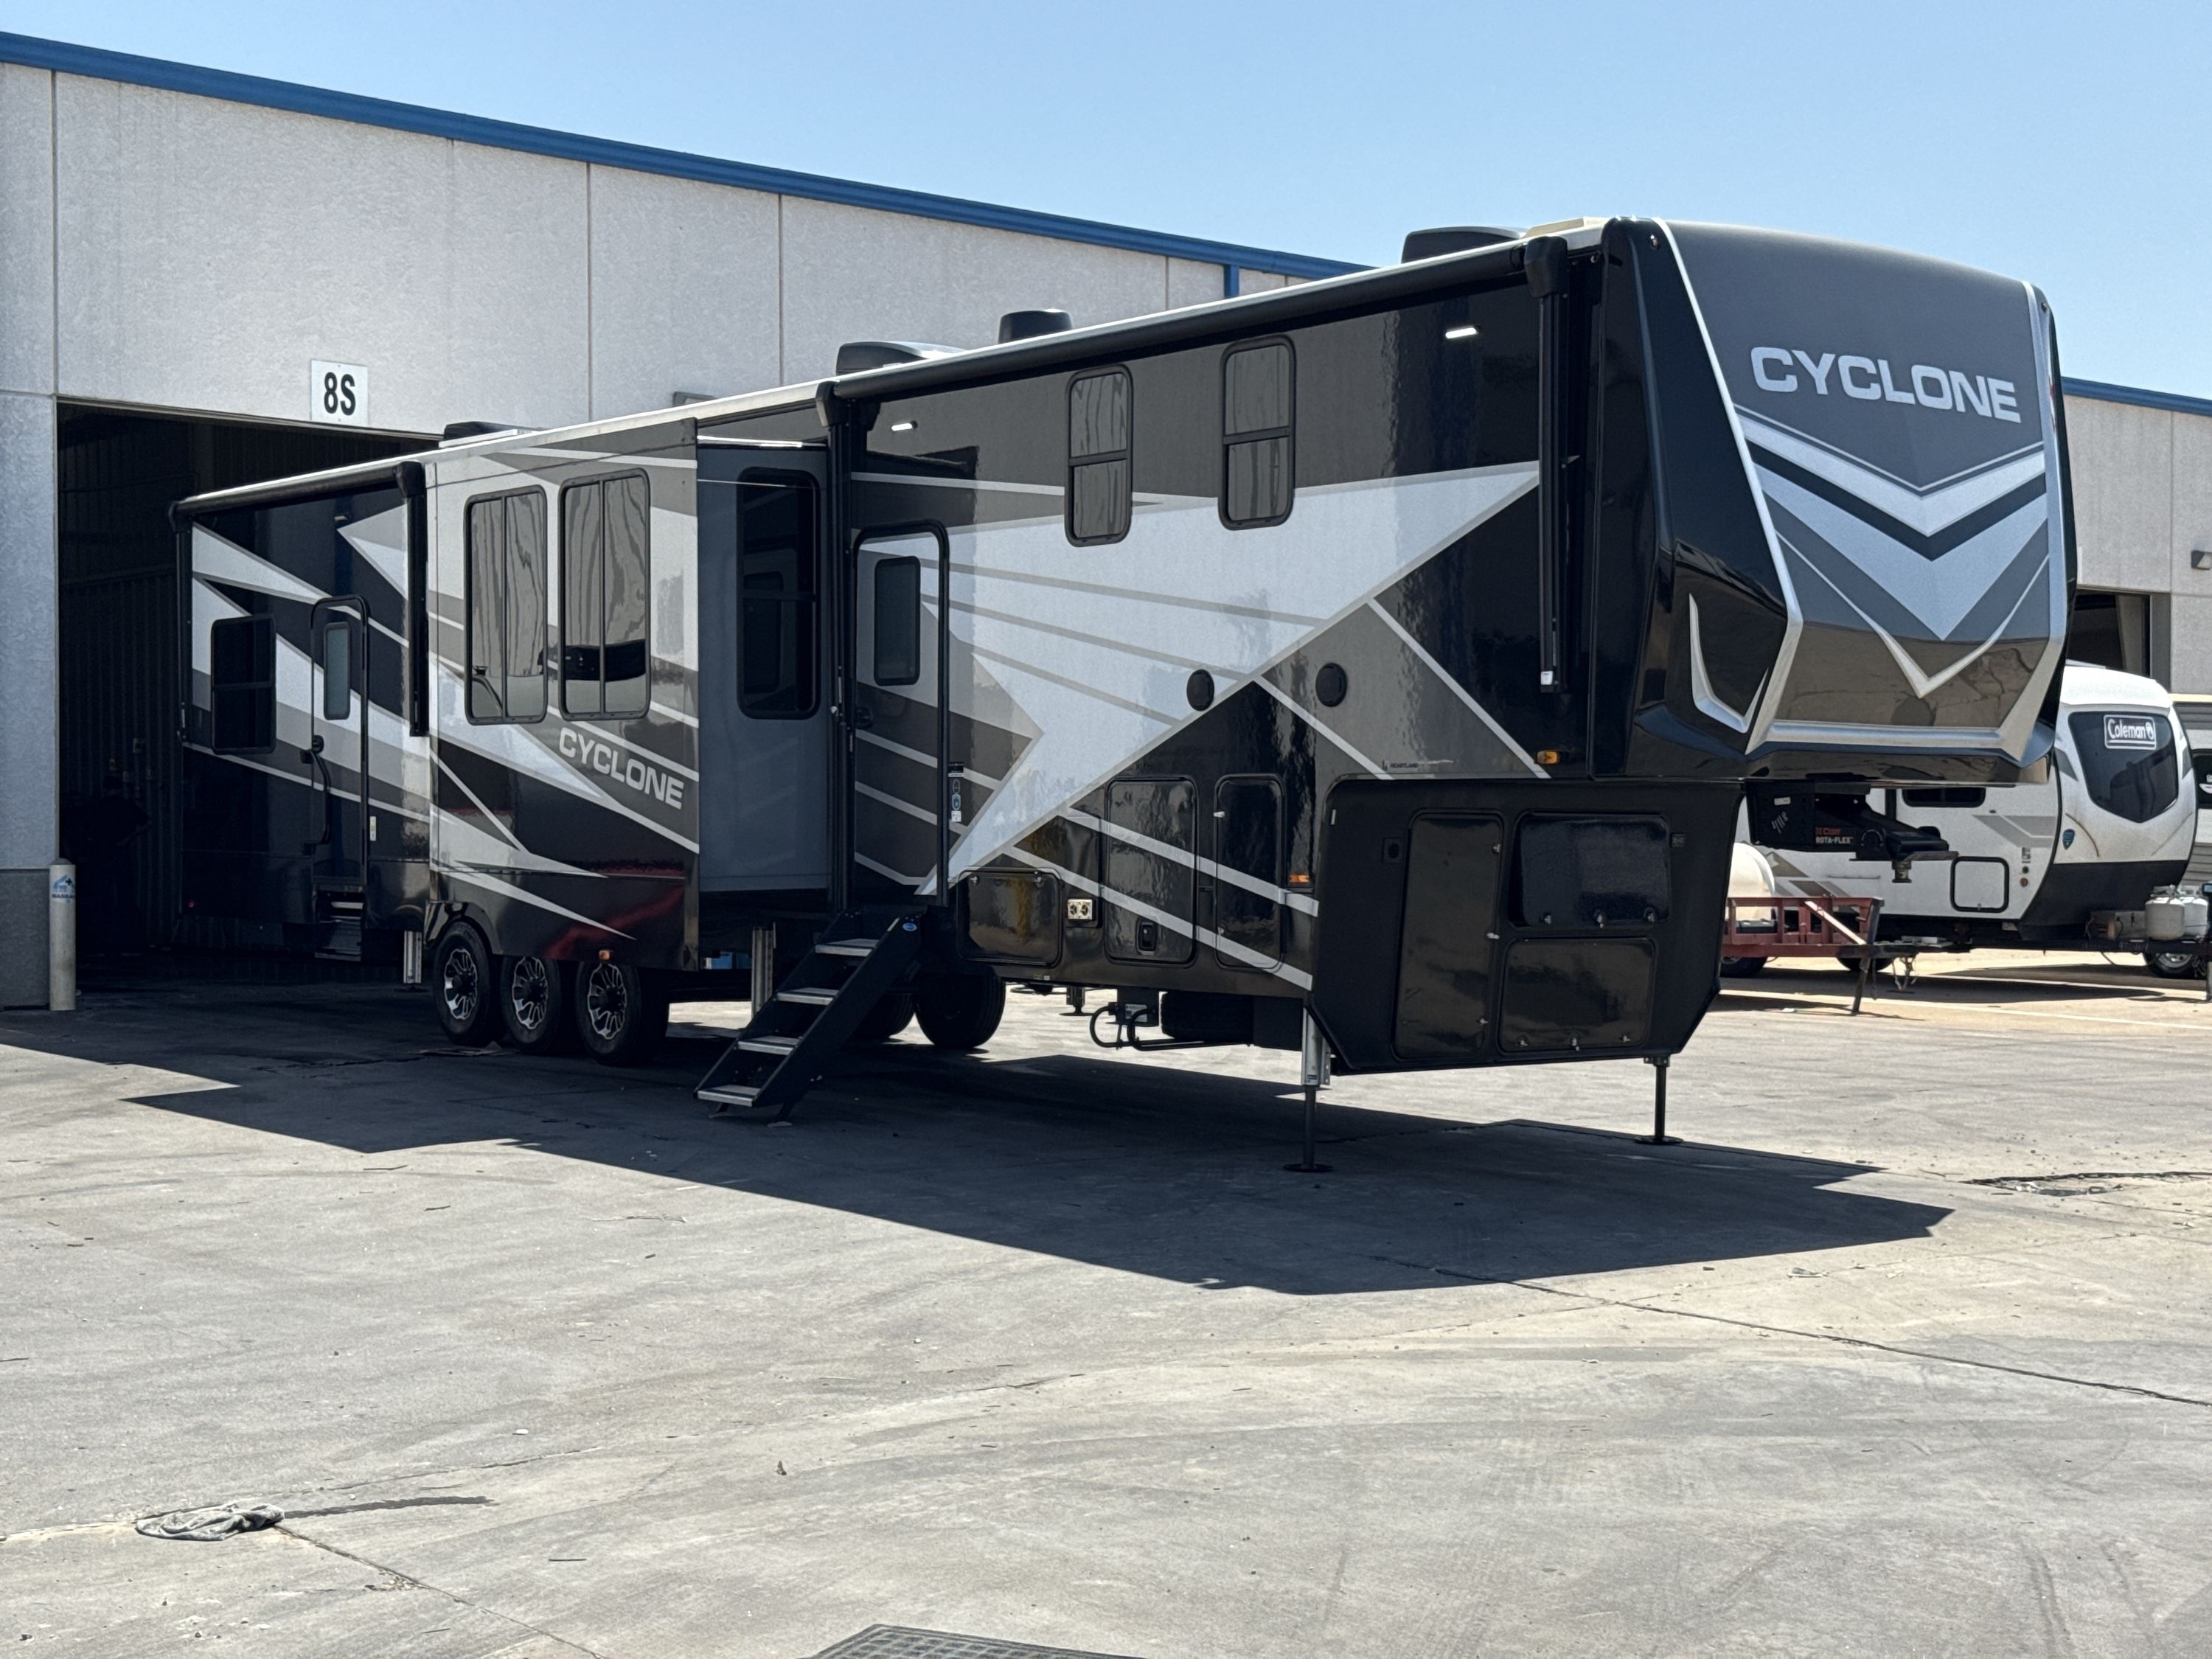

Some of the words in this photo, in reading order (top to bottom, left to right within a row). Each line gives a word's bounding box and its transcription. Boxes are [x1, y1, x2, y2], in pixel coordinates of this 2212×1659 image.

[324, 372, 356, 416] 8S
[1750, 347, 2022, 423] CYCLONE
[2107, 718, 2146, 739] Coleman
[559, 726, 685, 810] CYCLONE
[1815, 836, 1851, 844] ROTA-FLEX
